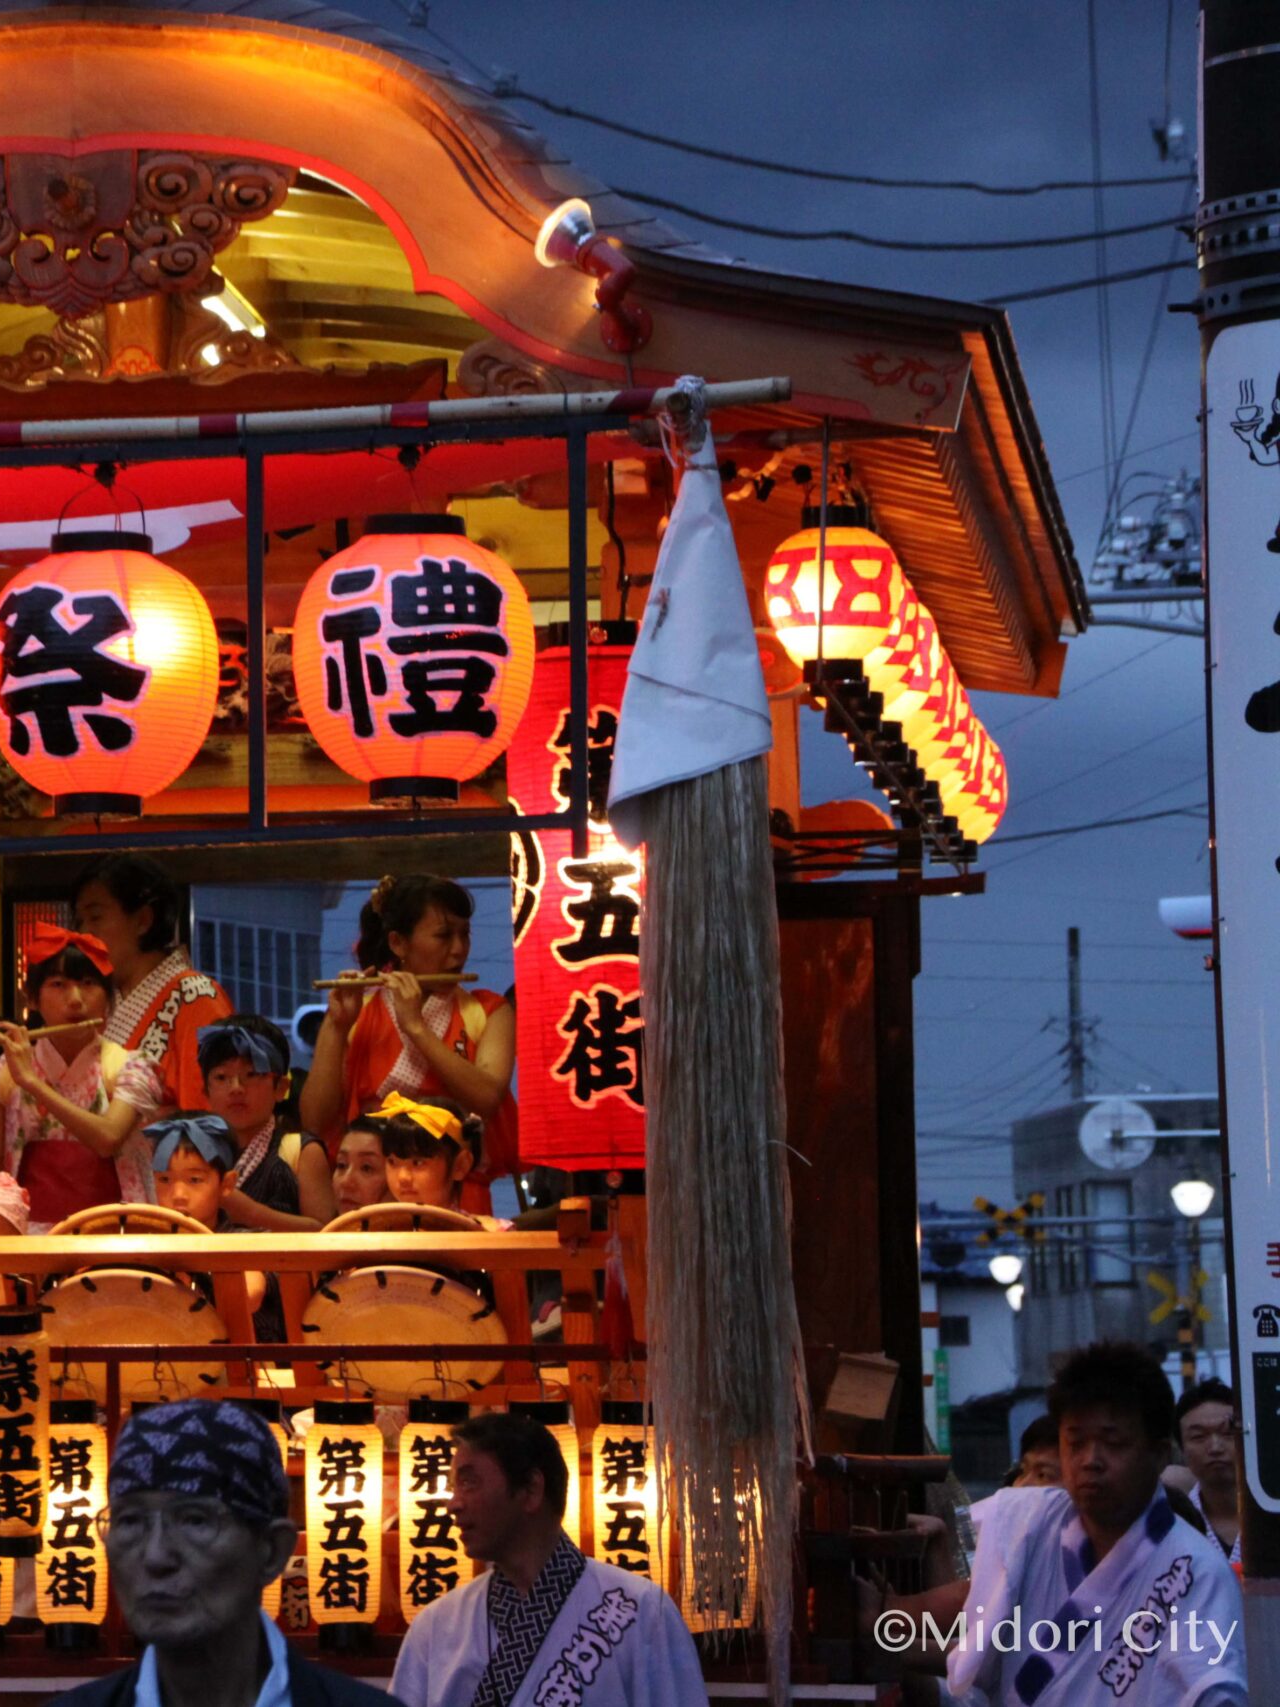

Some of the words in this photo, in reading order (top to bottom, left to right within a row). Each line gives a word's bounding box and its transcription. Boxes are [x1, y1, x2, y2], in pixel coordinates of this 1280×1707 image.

[321, 558, 510, 738] 禮
[47, 1438, 97, 1611] 第五街
[316, 1436, 370, 1613] 第五街
[405, 1434, 461, 1606] 第五街
